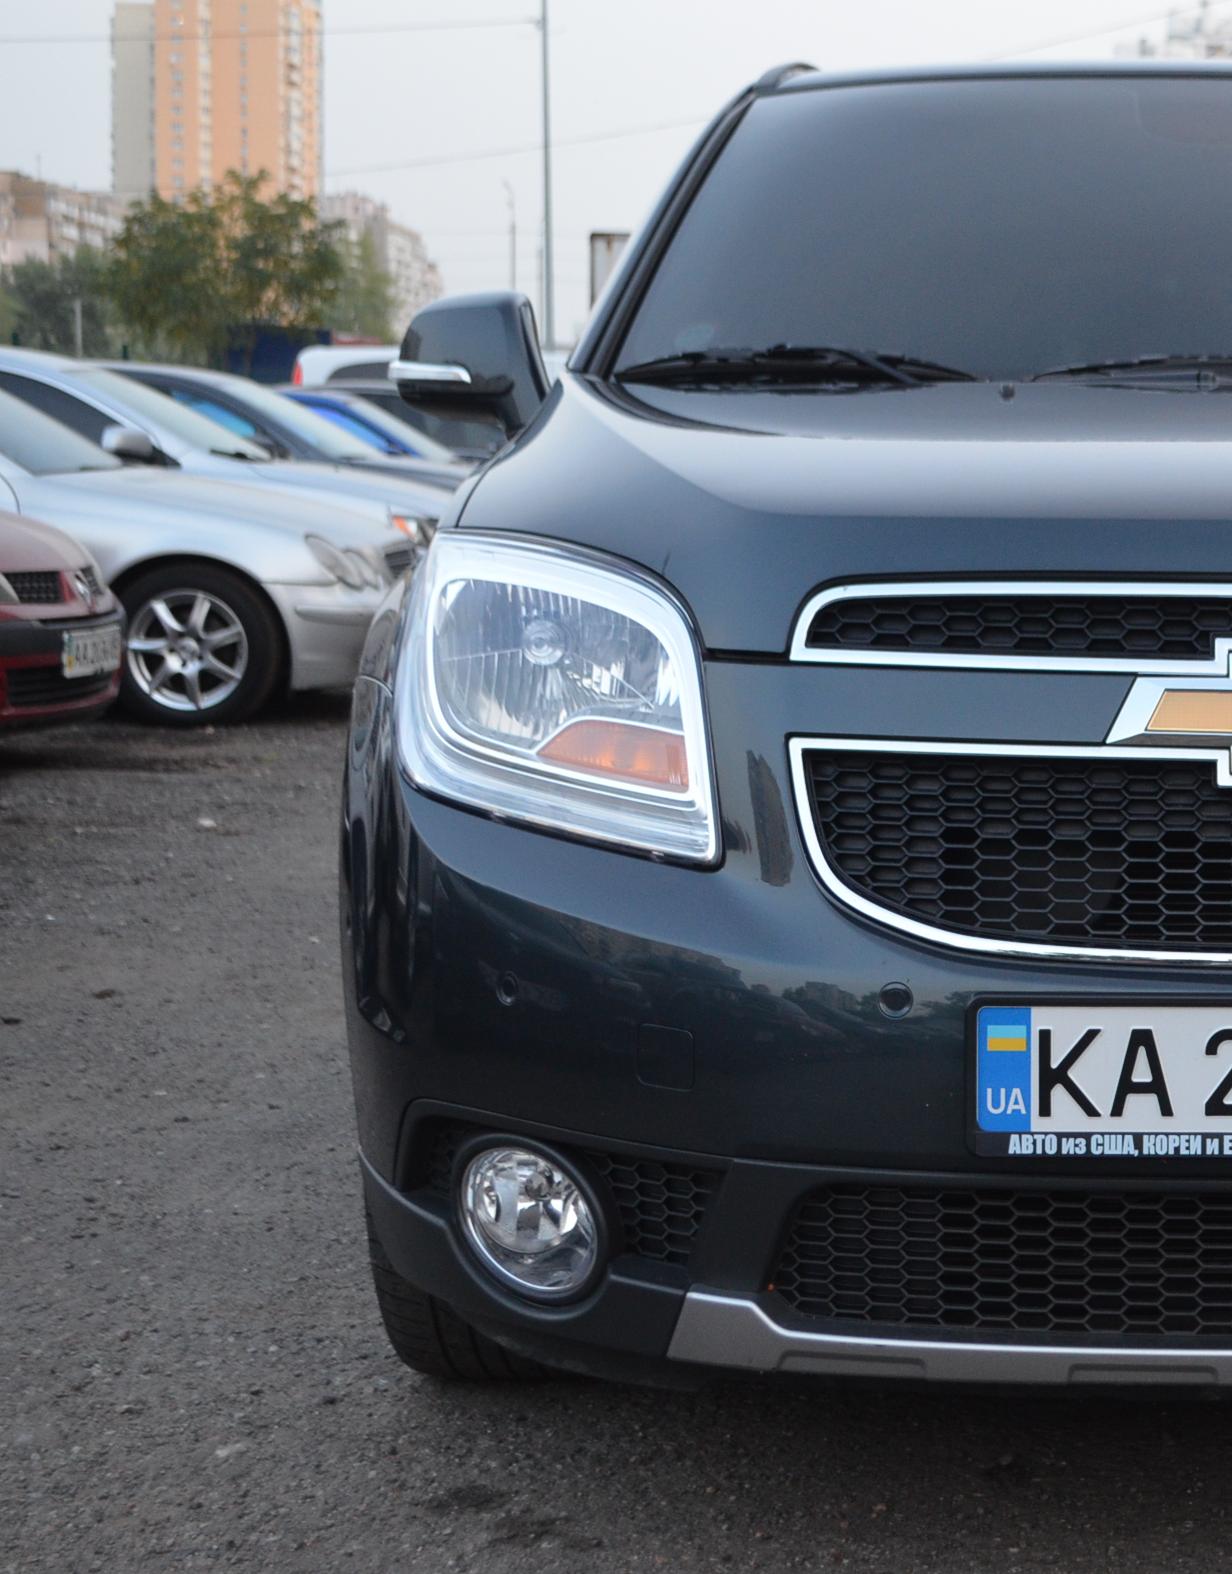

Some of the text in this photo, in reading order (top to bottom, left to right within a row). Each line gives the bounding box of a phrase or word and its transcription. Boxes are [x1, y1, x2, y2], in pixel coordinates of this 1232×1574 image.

[1037, 1027, 1174, 1118] KA
[986, 1087, 1027, 1115] UA
[1007, 1134, 1058, 1155] АВТО
[1060, 1138, 1088, 1154] из
[1090, 1134, 1139, 1157] США,
[1142, 1134, 1203, 1155] КОРЕИ
